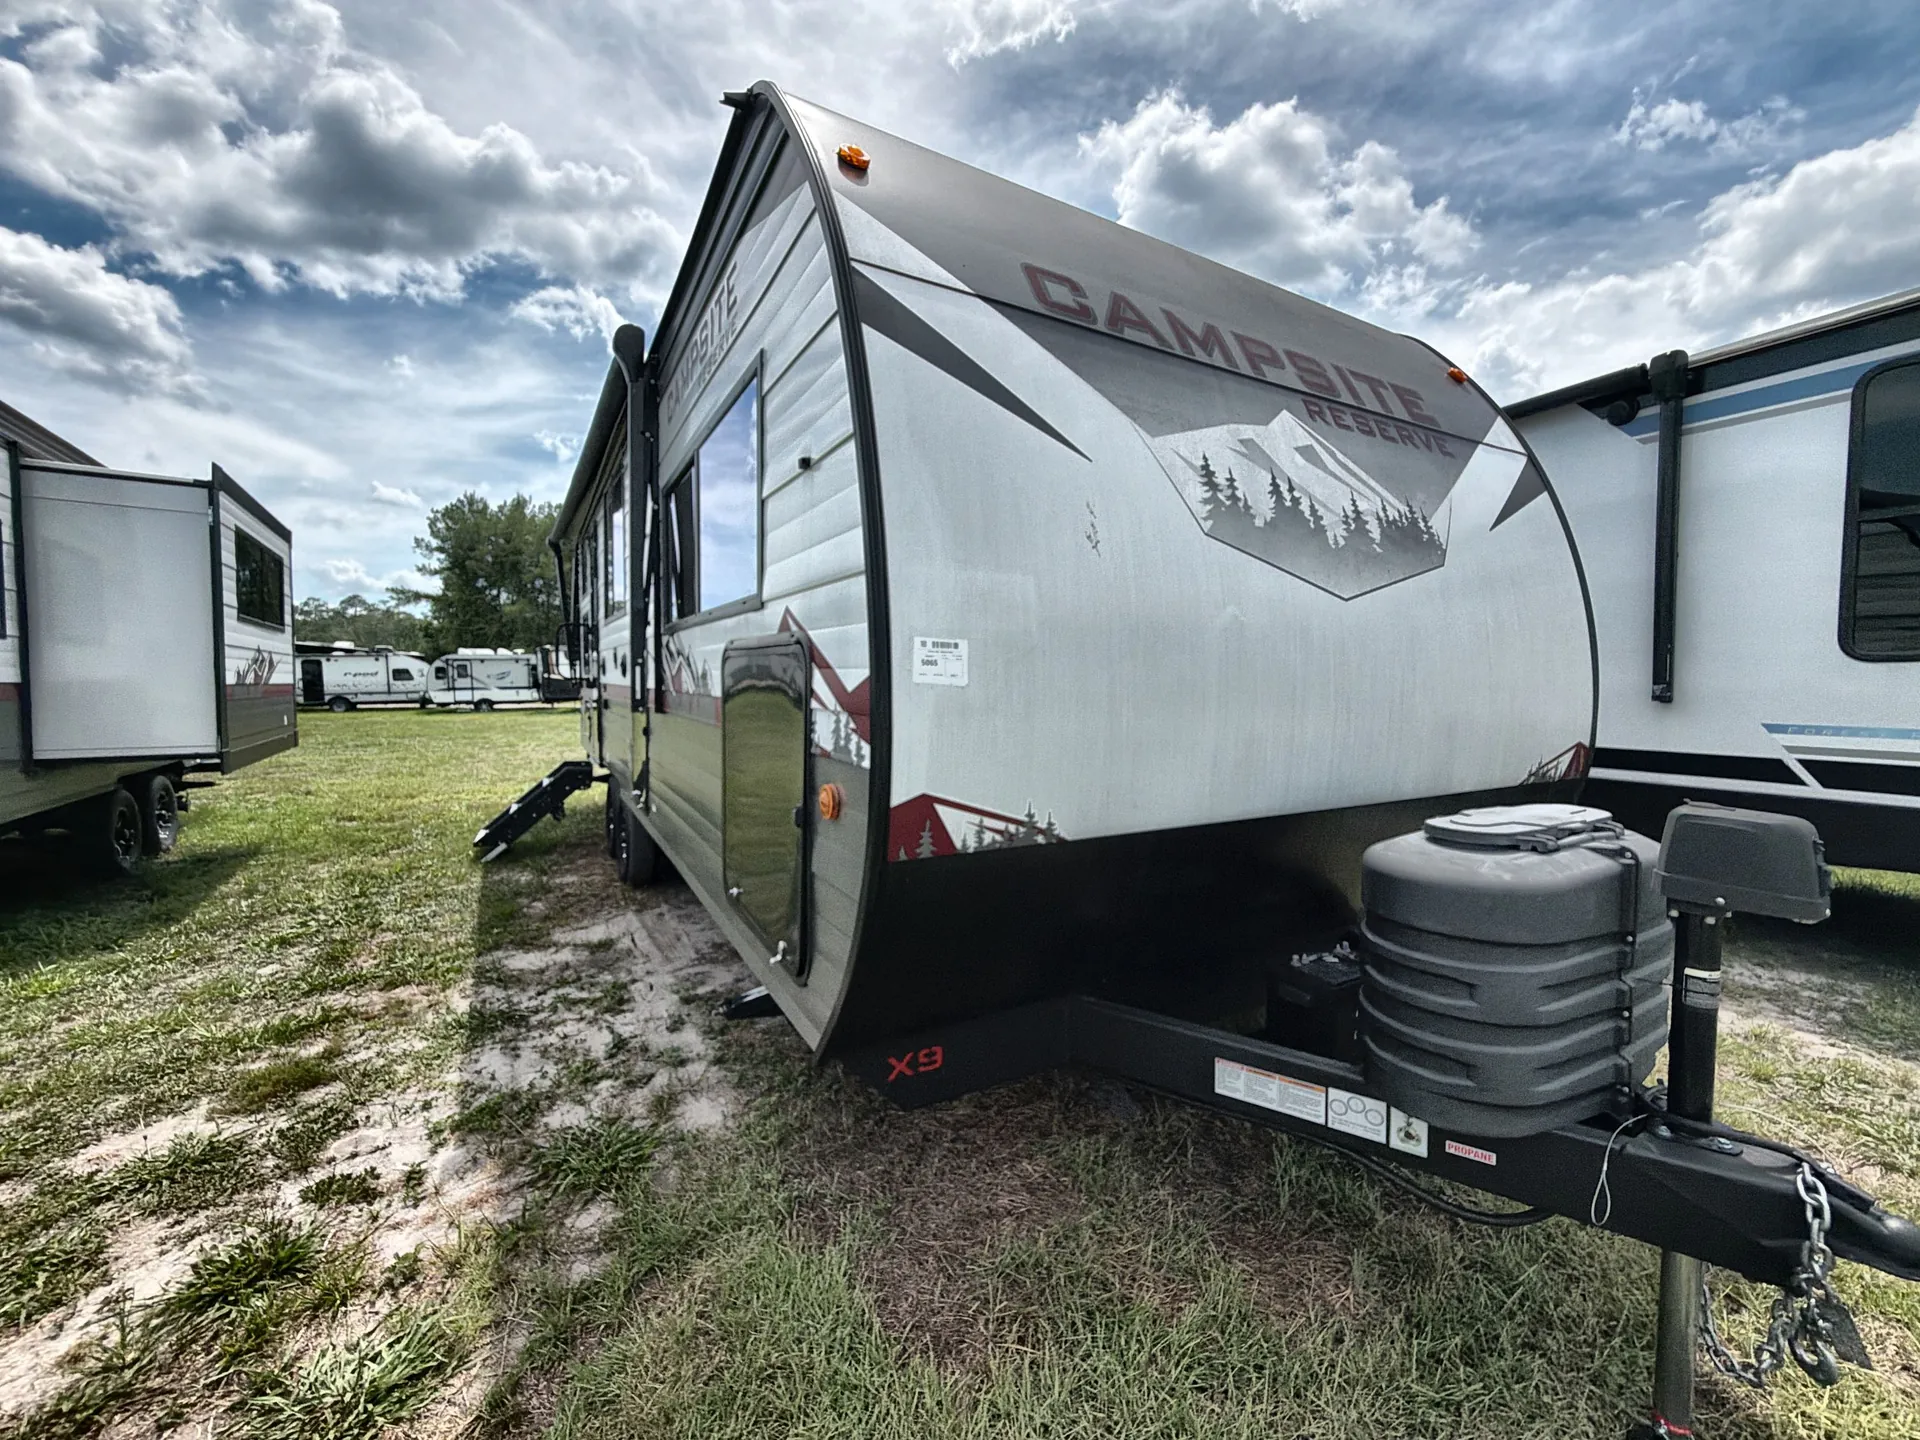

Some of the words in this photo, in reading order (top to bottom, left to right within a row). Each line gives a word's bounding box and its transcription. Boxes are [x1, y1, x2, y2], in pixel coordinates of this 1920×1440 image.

[1020, 262, 1442, 429] CAMPSITE
[1301, 398, 1456, 459] RESERVE
[887, 1046, 944, 1083] X9
[1446, 1142, 1495, 1163] PROPANE
